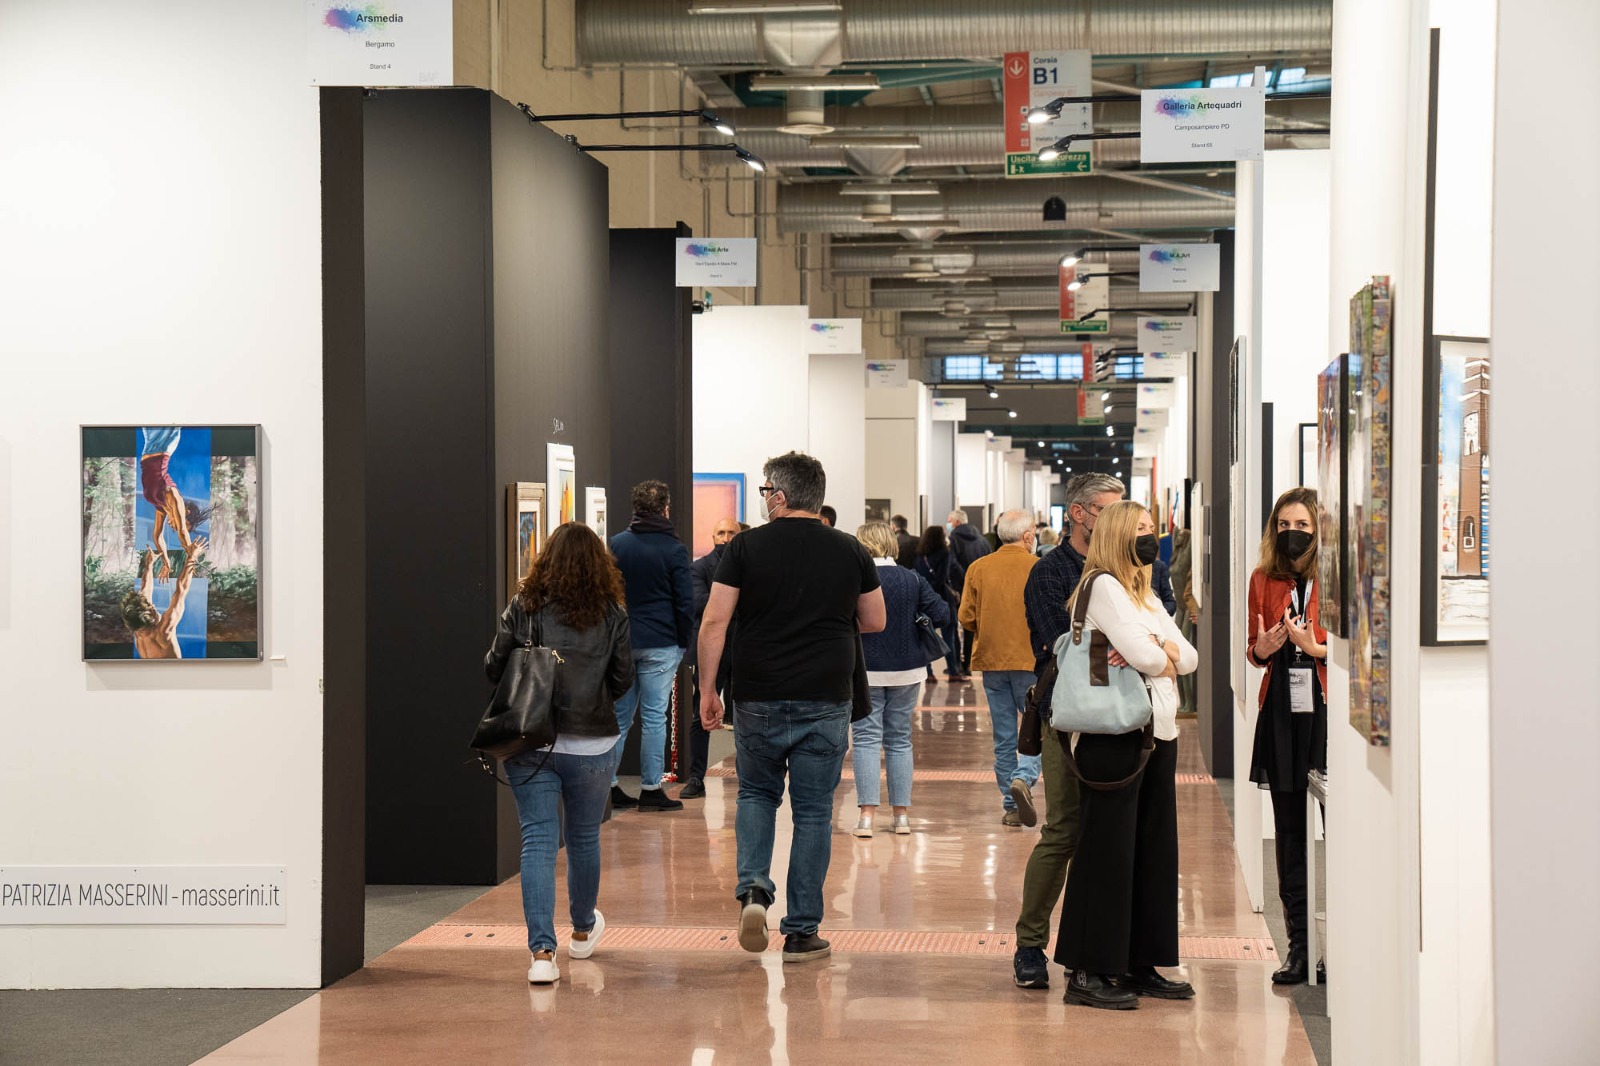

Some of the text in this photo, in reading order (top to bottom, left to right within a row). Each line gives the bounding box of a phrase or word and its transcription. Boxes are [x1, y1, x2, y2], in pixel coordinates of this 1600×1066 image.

[356, 13, 404, 23] Arsmedia
[365, 41, 395, 49] Bergamo
[1033, 67, 1058, 85] B1
[1163, 100, 1243, 112] Galleria Artequadri
[1174, 124, 1220, 132] Camposampiero
[1010, 154, 1036, 163] Uscita
[2, 883, 72, 907] PATRIZIA
